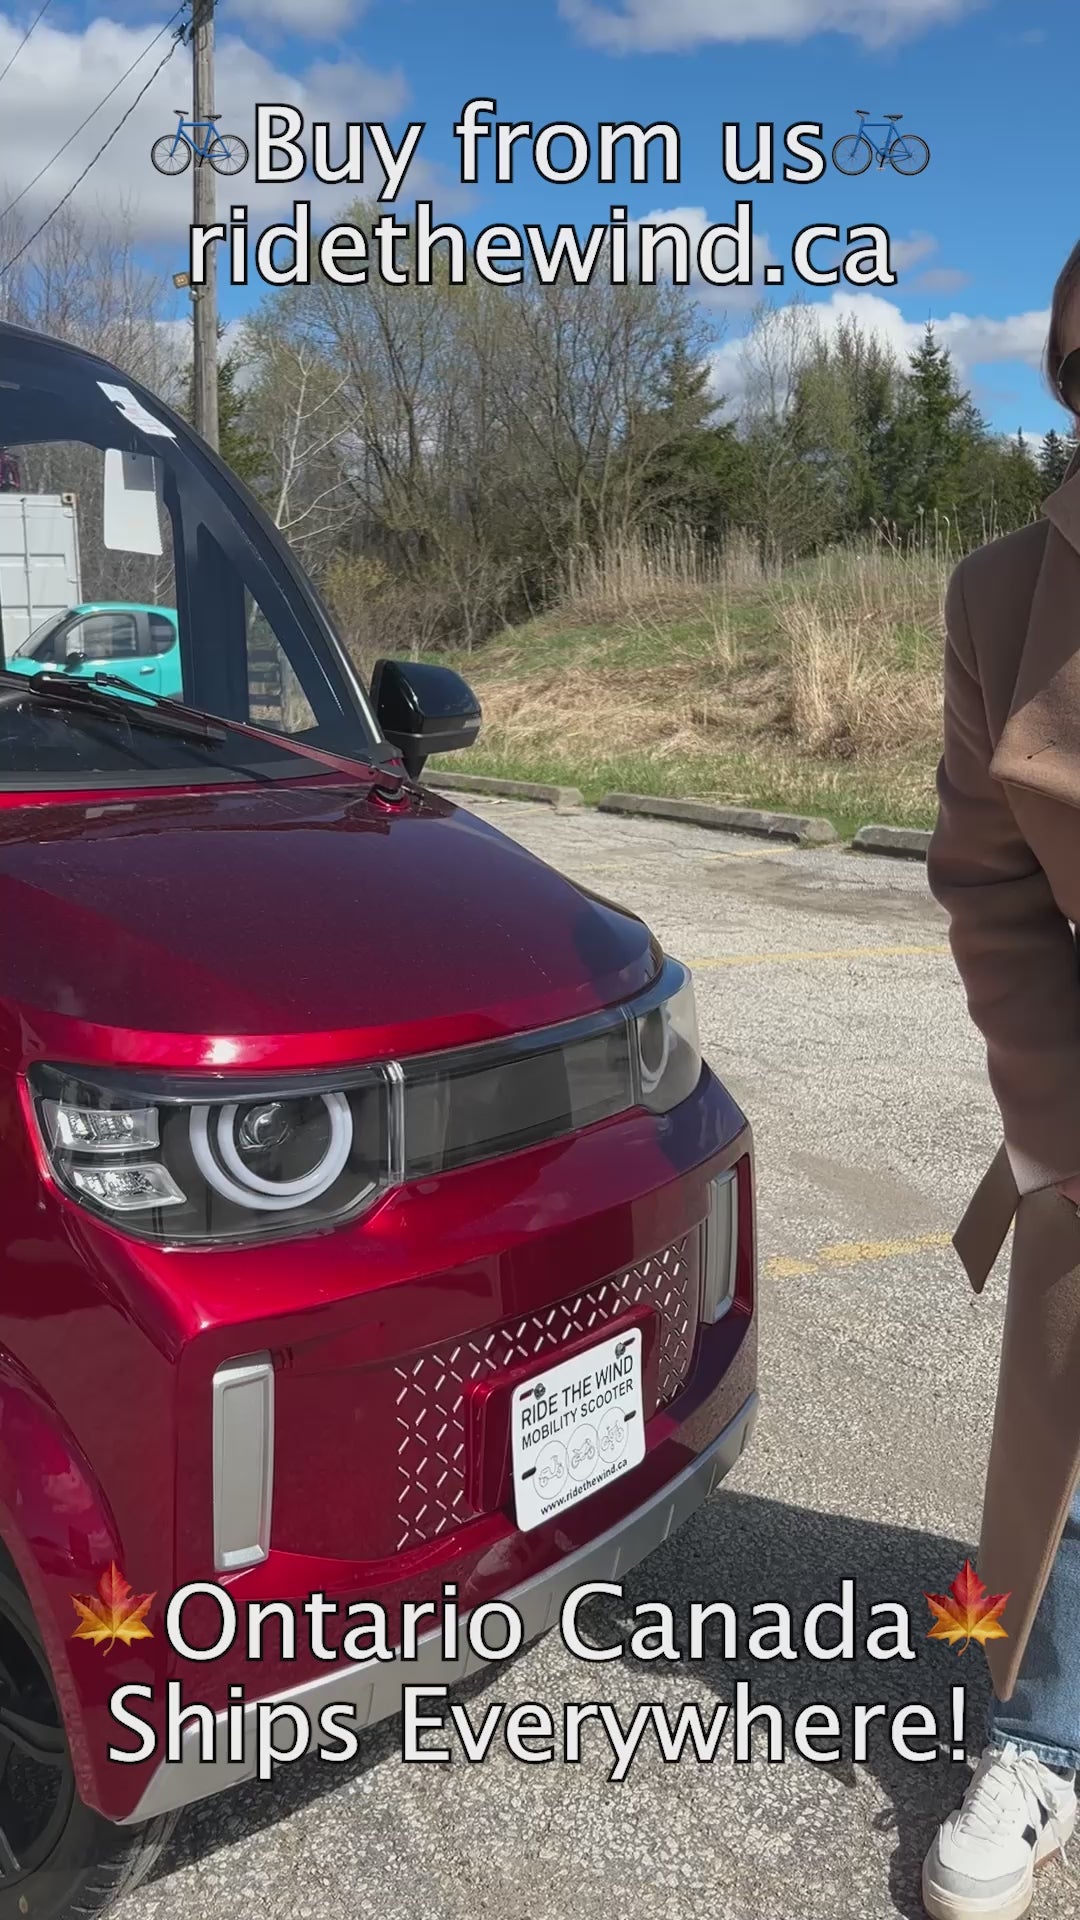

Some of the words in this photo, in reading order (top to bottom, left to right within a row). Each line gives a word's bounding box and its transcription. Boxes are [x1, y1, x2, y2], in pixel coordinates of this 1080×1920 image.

[521, 1392, 559, 1430] RIDE
[562, 1375, 592, 1405] THE
[595, 1354, 634, 1389] WIND
[521, 1407, 578, 1451] MOBILITY
[580, 1378, 634, 1419] SCOOTER
[540, 1458, 628, 1516] www.ridethewind.ca
